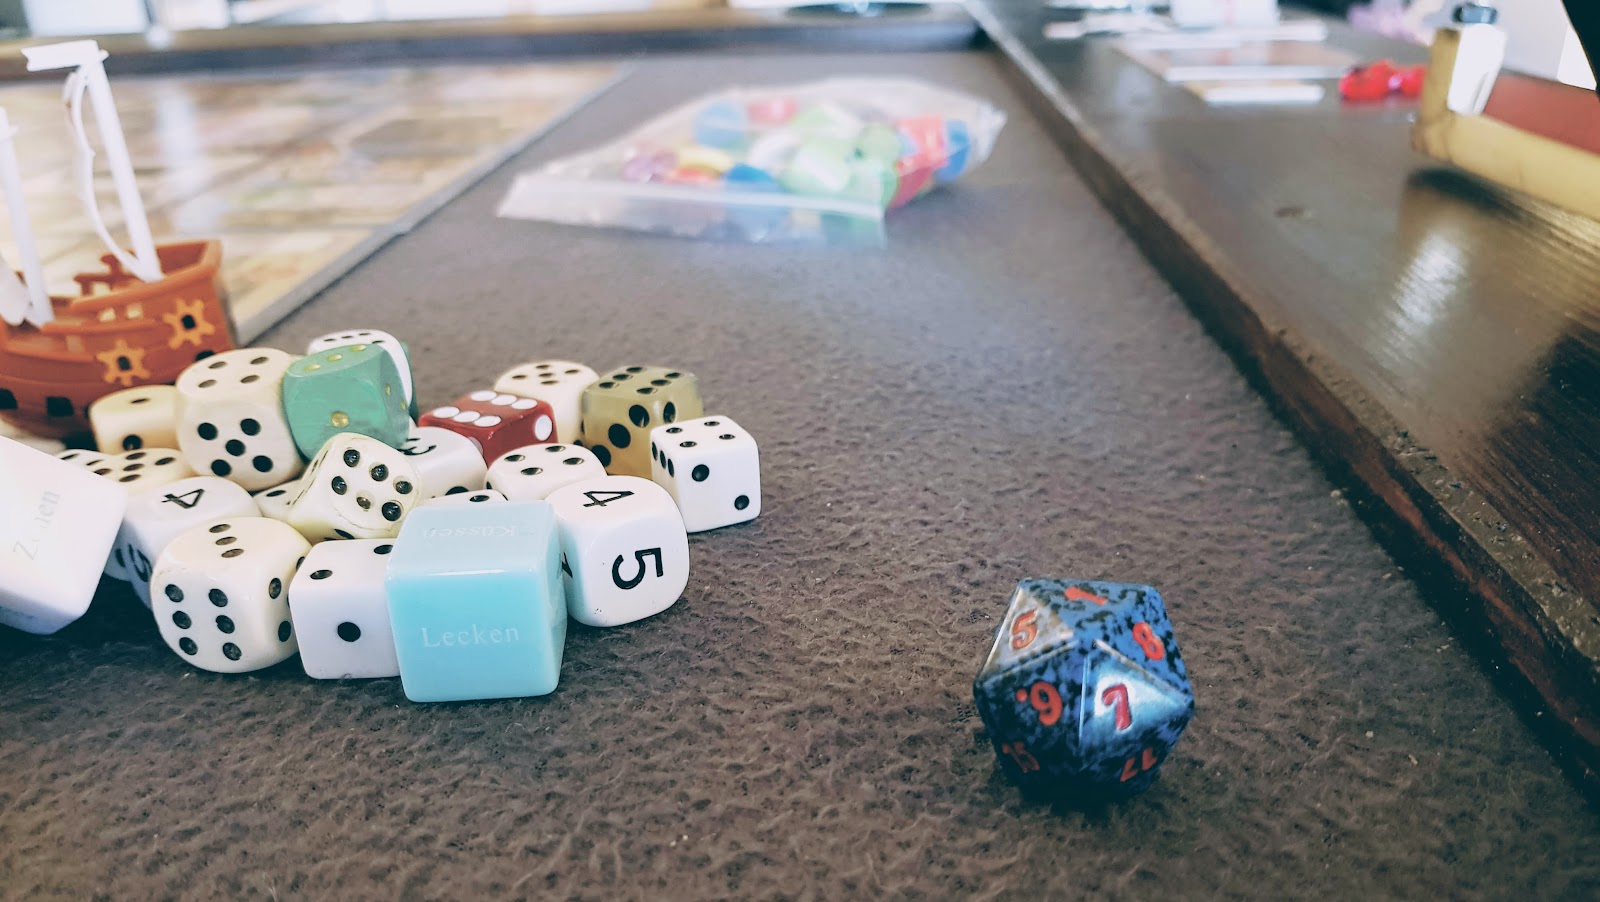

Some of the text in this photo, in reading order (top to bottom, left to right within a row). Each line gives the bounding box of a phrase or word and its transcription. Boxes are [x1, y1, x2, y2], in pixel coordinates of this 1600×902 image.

[161, 489, 205, 509] 4
[582, 491, 635, 507] 4
[612, 547, 664, 590] 5
[1064, 586, 1108, 606] 1
[421, 624, 520, 648] Lecken
[1011, 607, 1038, 650] 5
[1132, 621, 1165, 661] 8
[1102, 683, 1132, 731] 7
